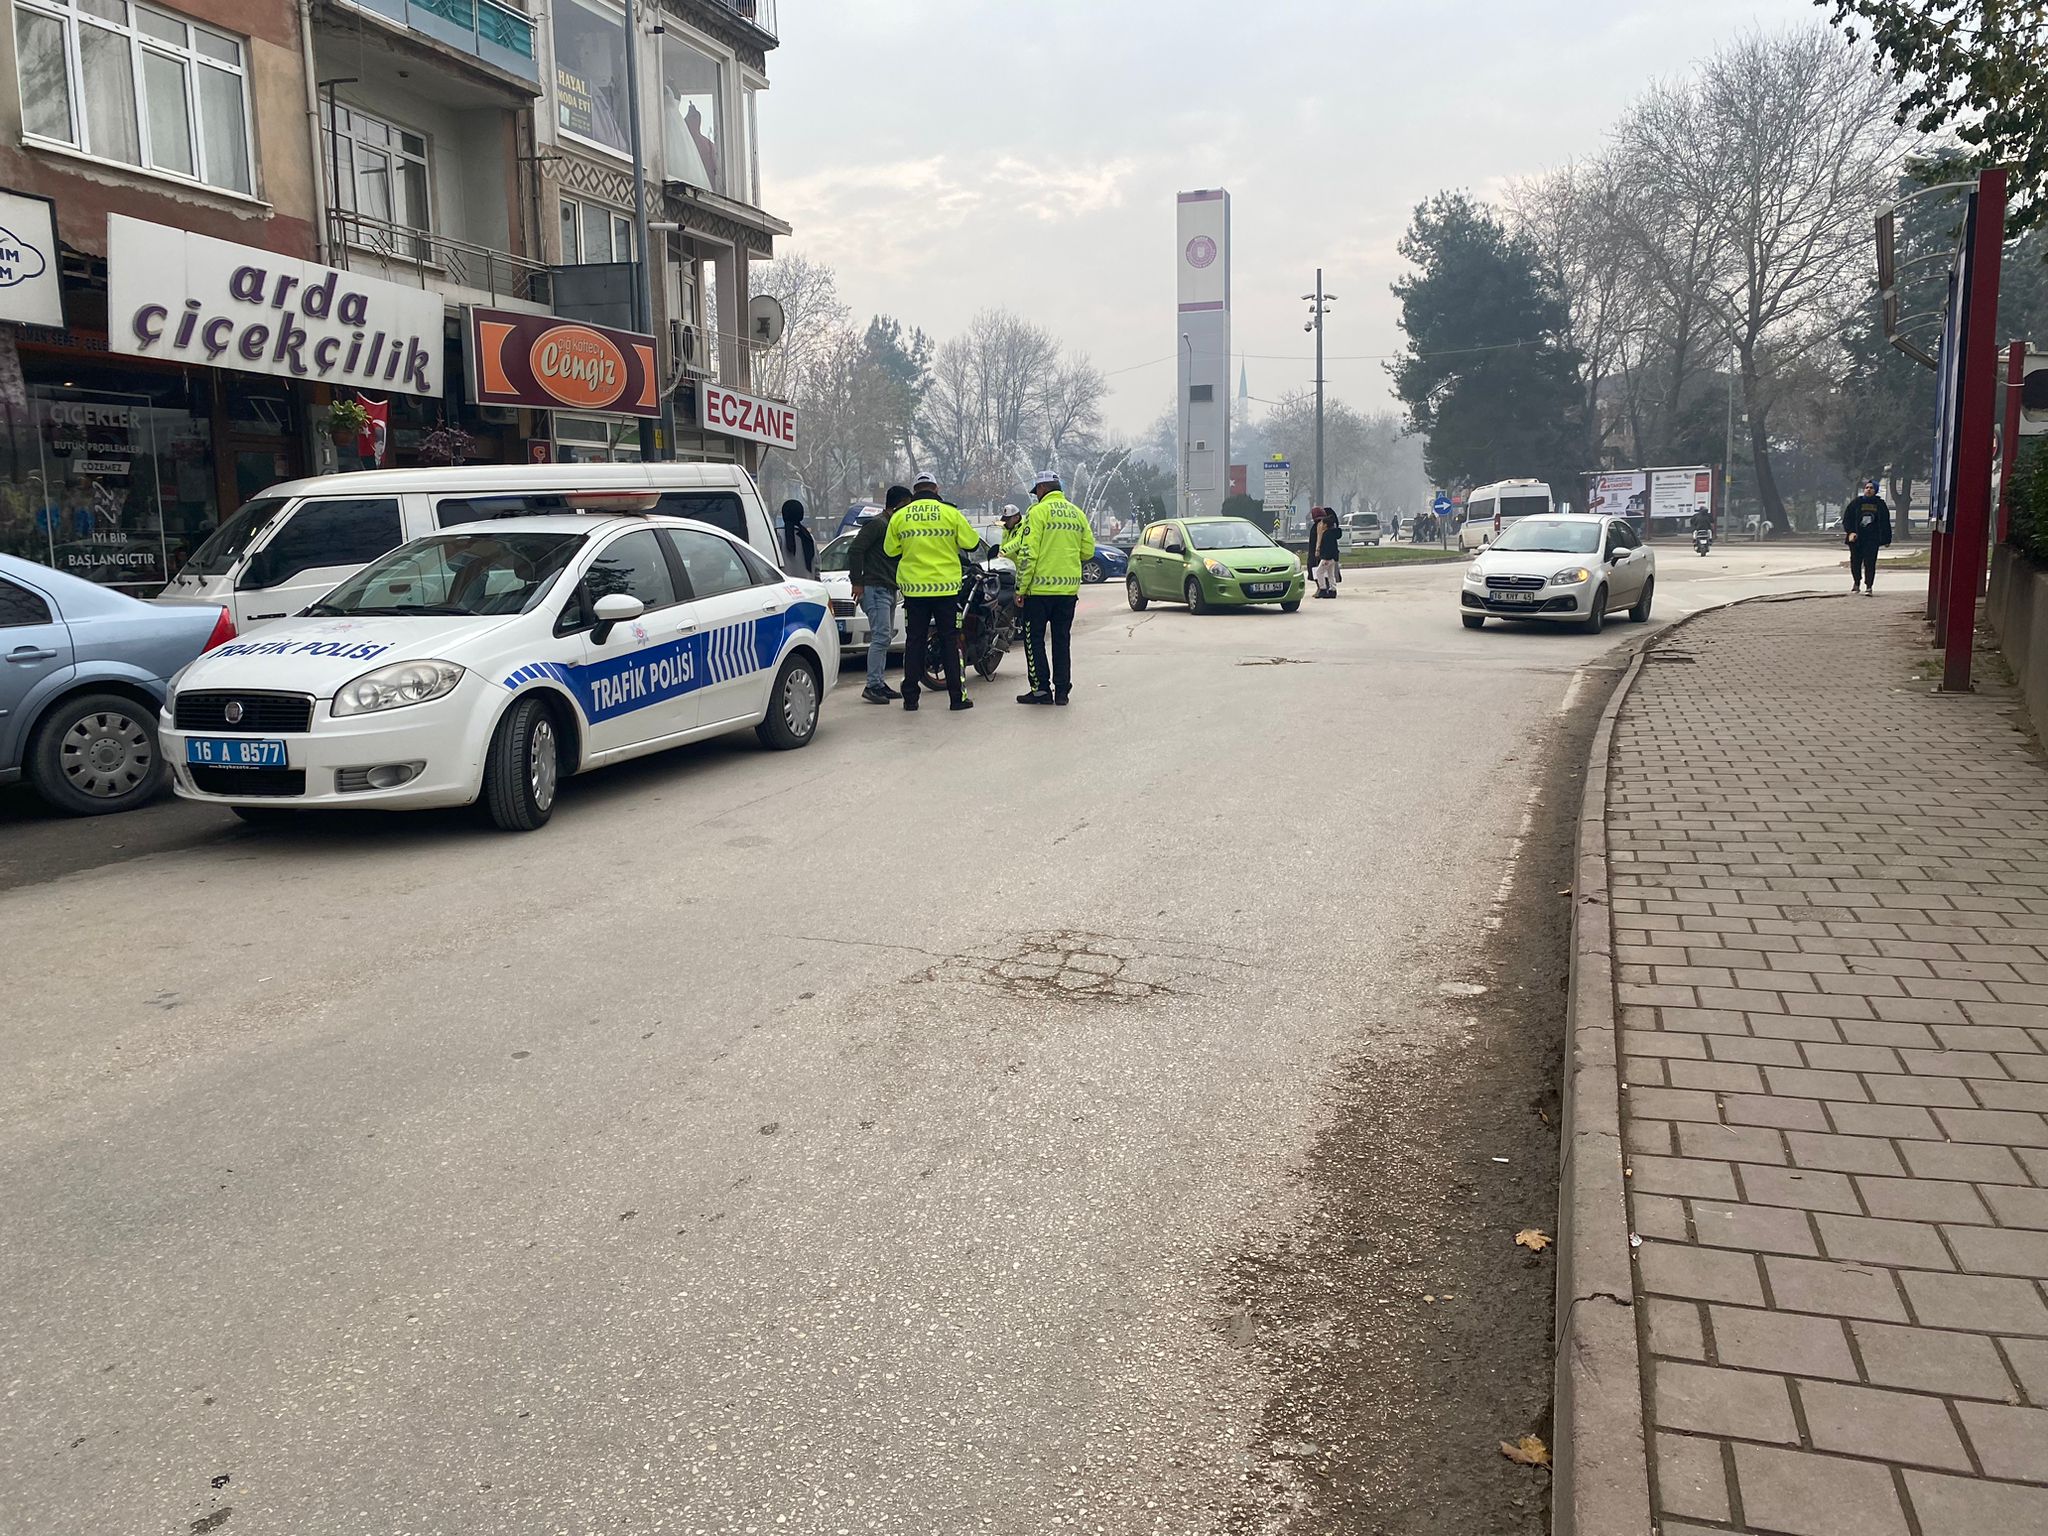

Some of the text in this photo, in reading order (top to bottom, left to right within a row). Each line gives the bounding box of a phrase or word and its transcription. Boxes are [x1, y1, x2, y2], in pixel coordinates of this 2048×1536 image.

[229, 265, 369, 327] arda
[133, 298, 431, 392] çiçekçilik
[541, 342, 616, 391] Cengiz
[707, 390, 794, 442] ECZANE
[905, 512, 941, 522] POLİSİ
[207, 639, 396, 661] TRAFİK POLİSİ
[591, 642, 695, 712] TRAFİK POLİSİ
[195, 741, 280, 763] 16 A 8577
